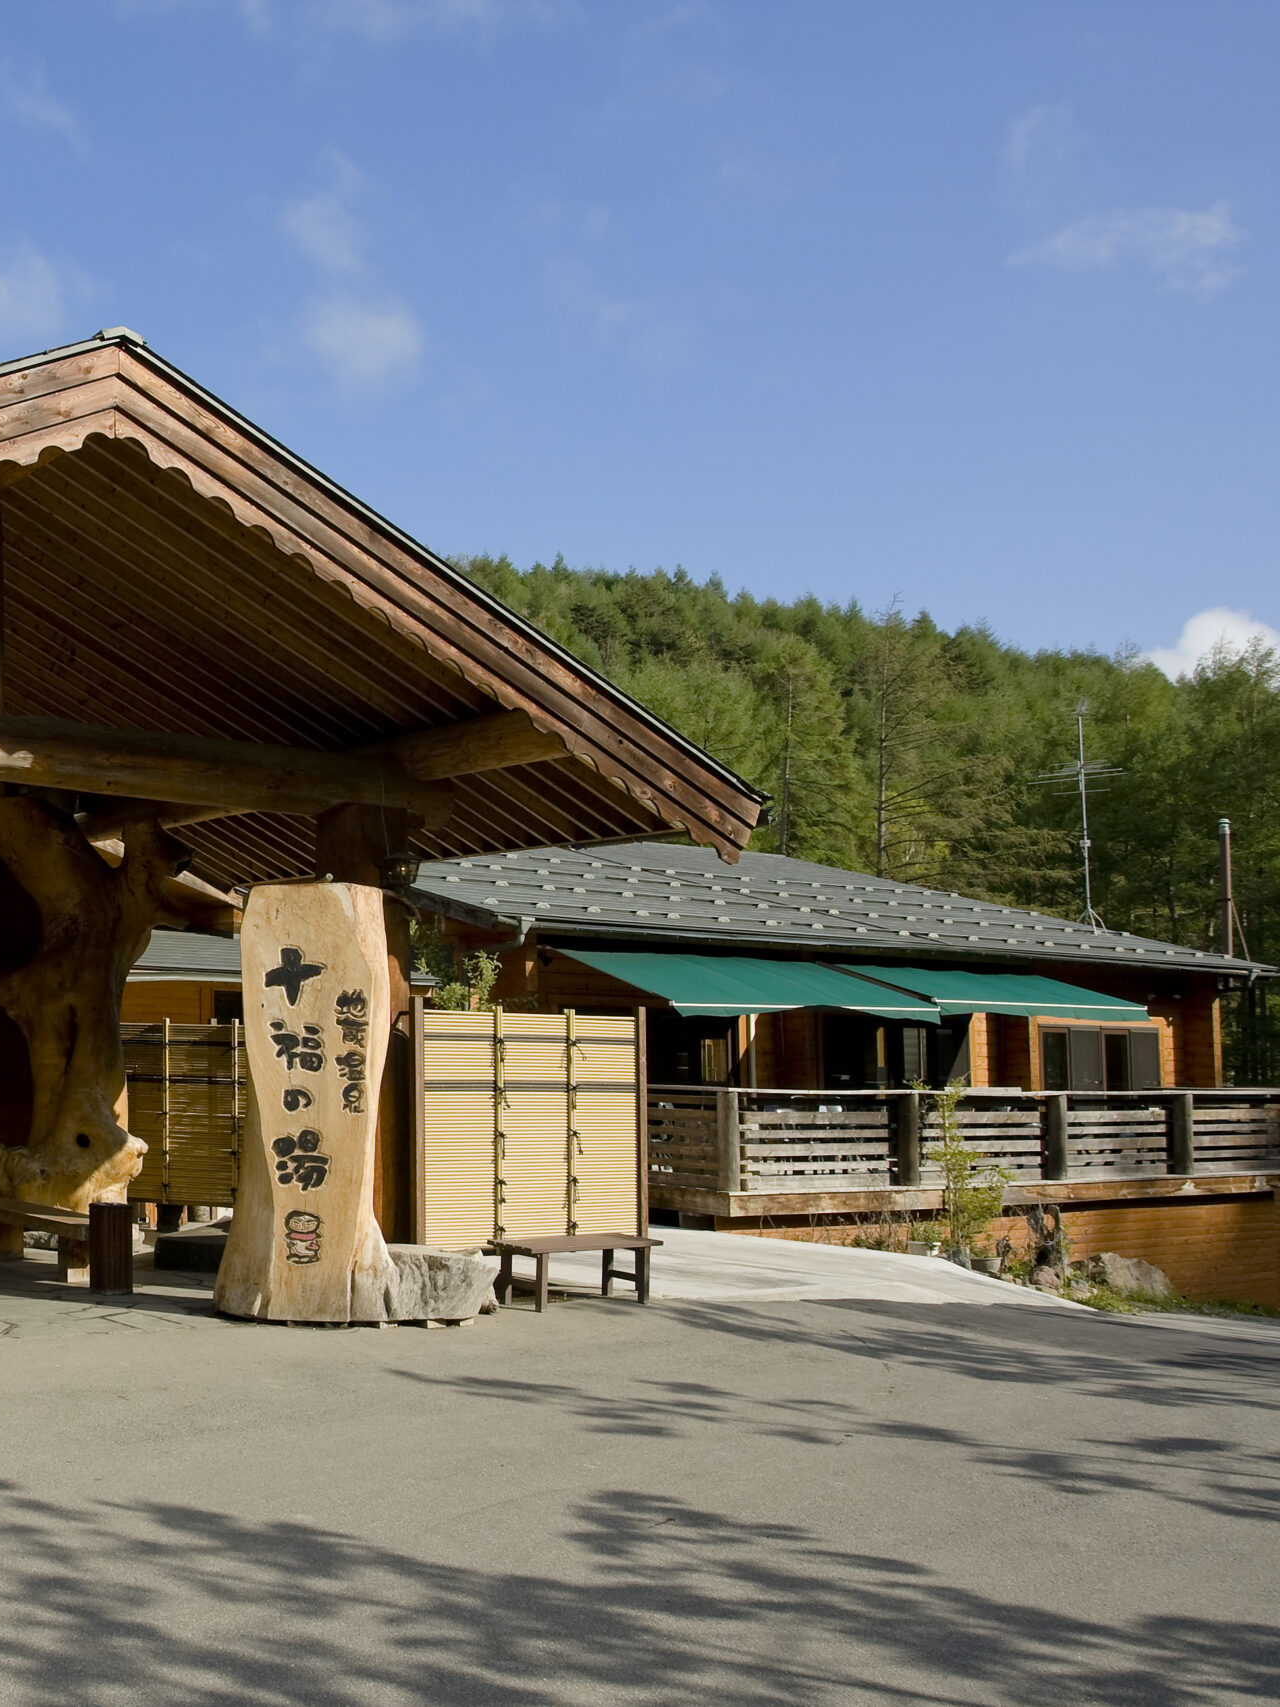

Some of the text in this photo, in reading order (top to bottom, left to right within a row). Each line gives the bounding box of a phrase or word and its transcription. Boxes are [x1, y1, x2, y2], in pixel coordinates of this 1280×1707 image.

[265, 946, 330, 1190] 十福の湯
[334, 989, 368, 1114] 地蔵温泉
